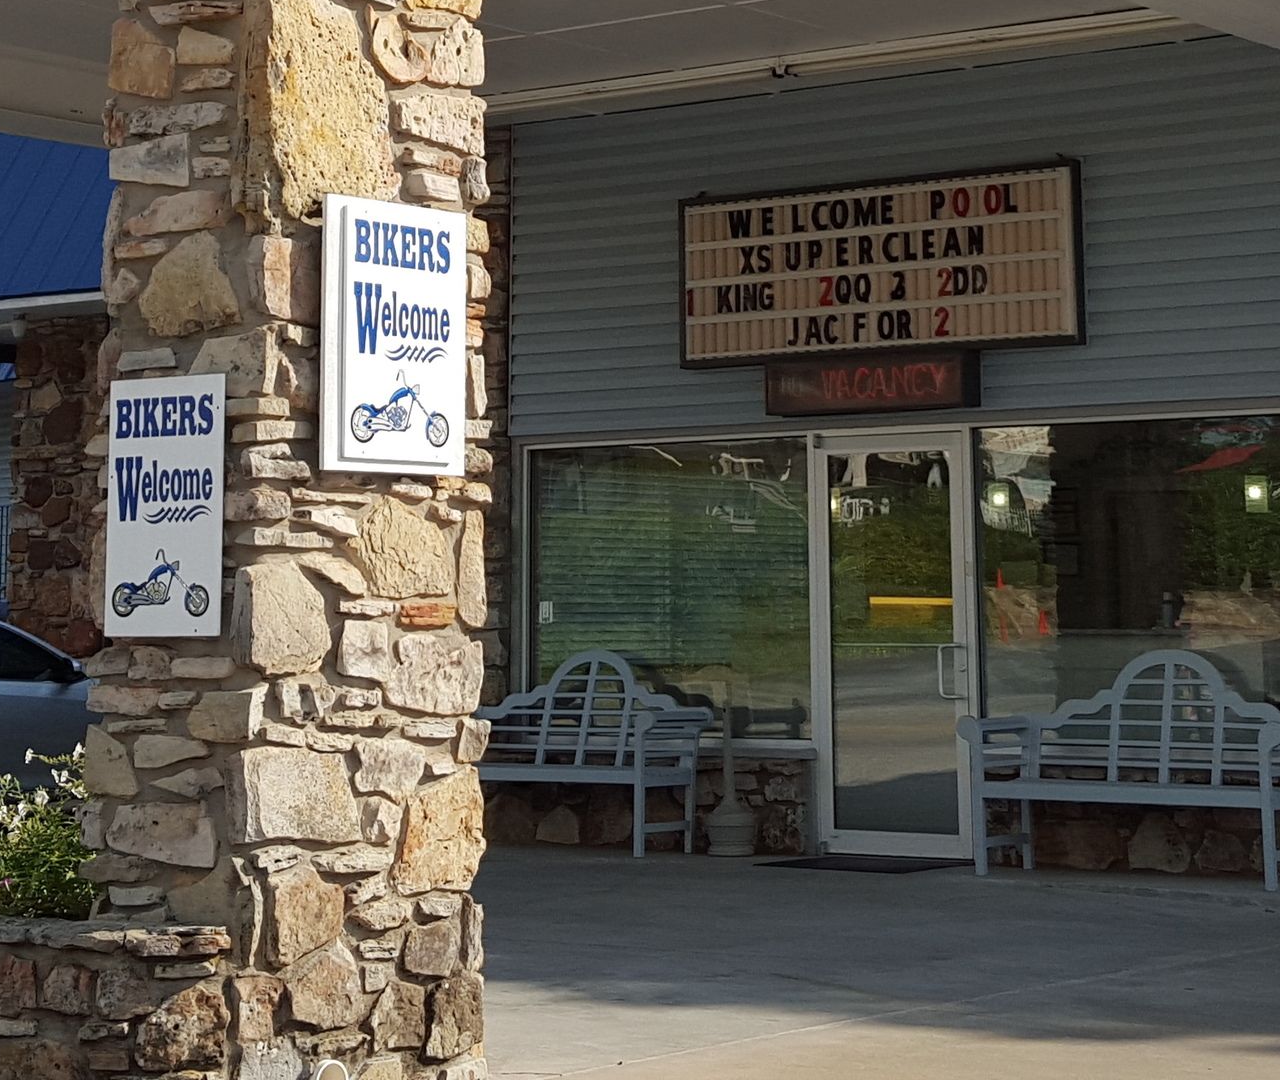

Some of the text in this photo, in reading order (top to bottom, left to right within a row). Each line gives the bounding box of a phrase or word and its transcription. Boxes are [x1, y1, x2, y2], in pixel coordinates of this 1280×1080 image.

[728, 184, 1017, 238] WELCOME POOL
[354, 218, 451, 274] BIKERS
[353, 281, 450, 355] Welcome
[718, 282, 774, 314] KING
[788, 307, 950, 346] JAC FOR 2
[821, 363, 945, 400] VACANCY
[116, 393, 213, 439] BIKERS
[115, 456, 212, 522] Welcome
